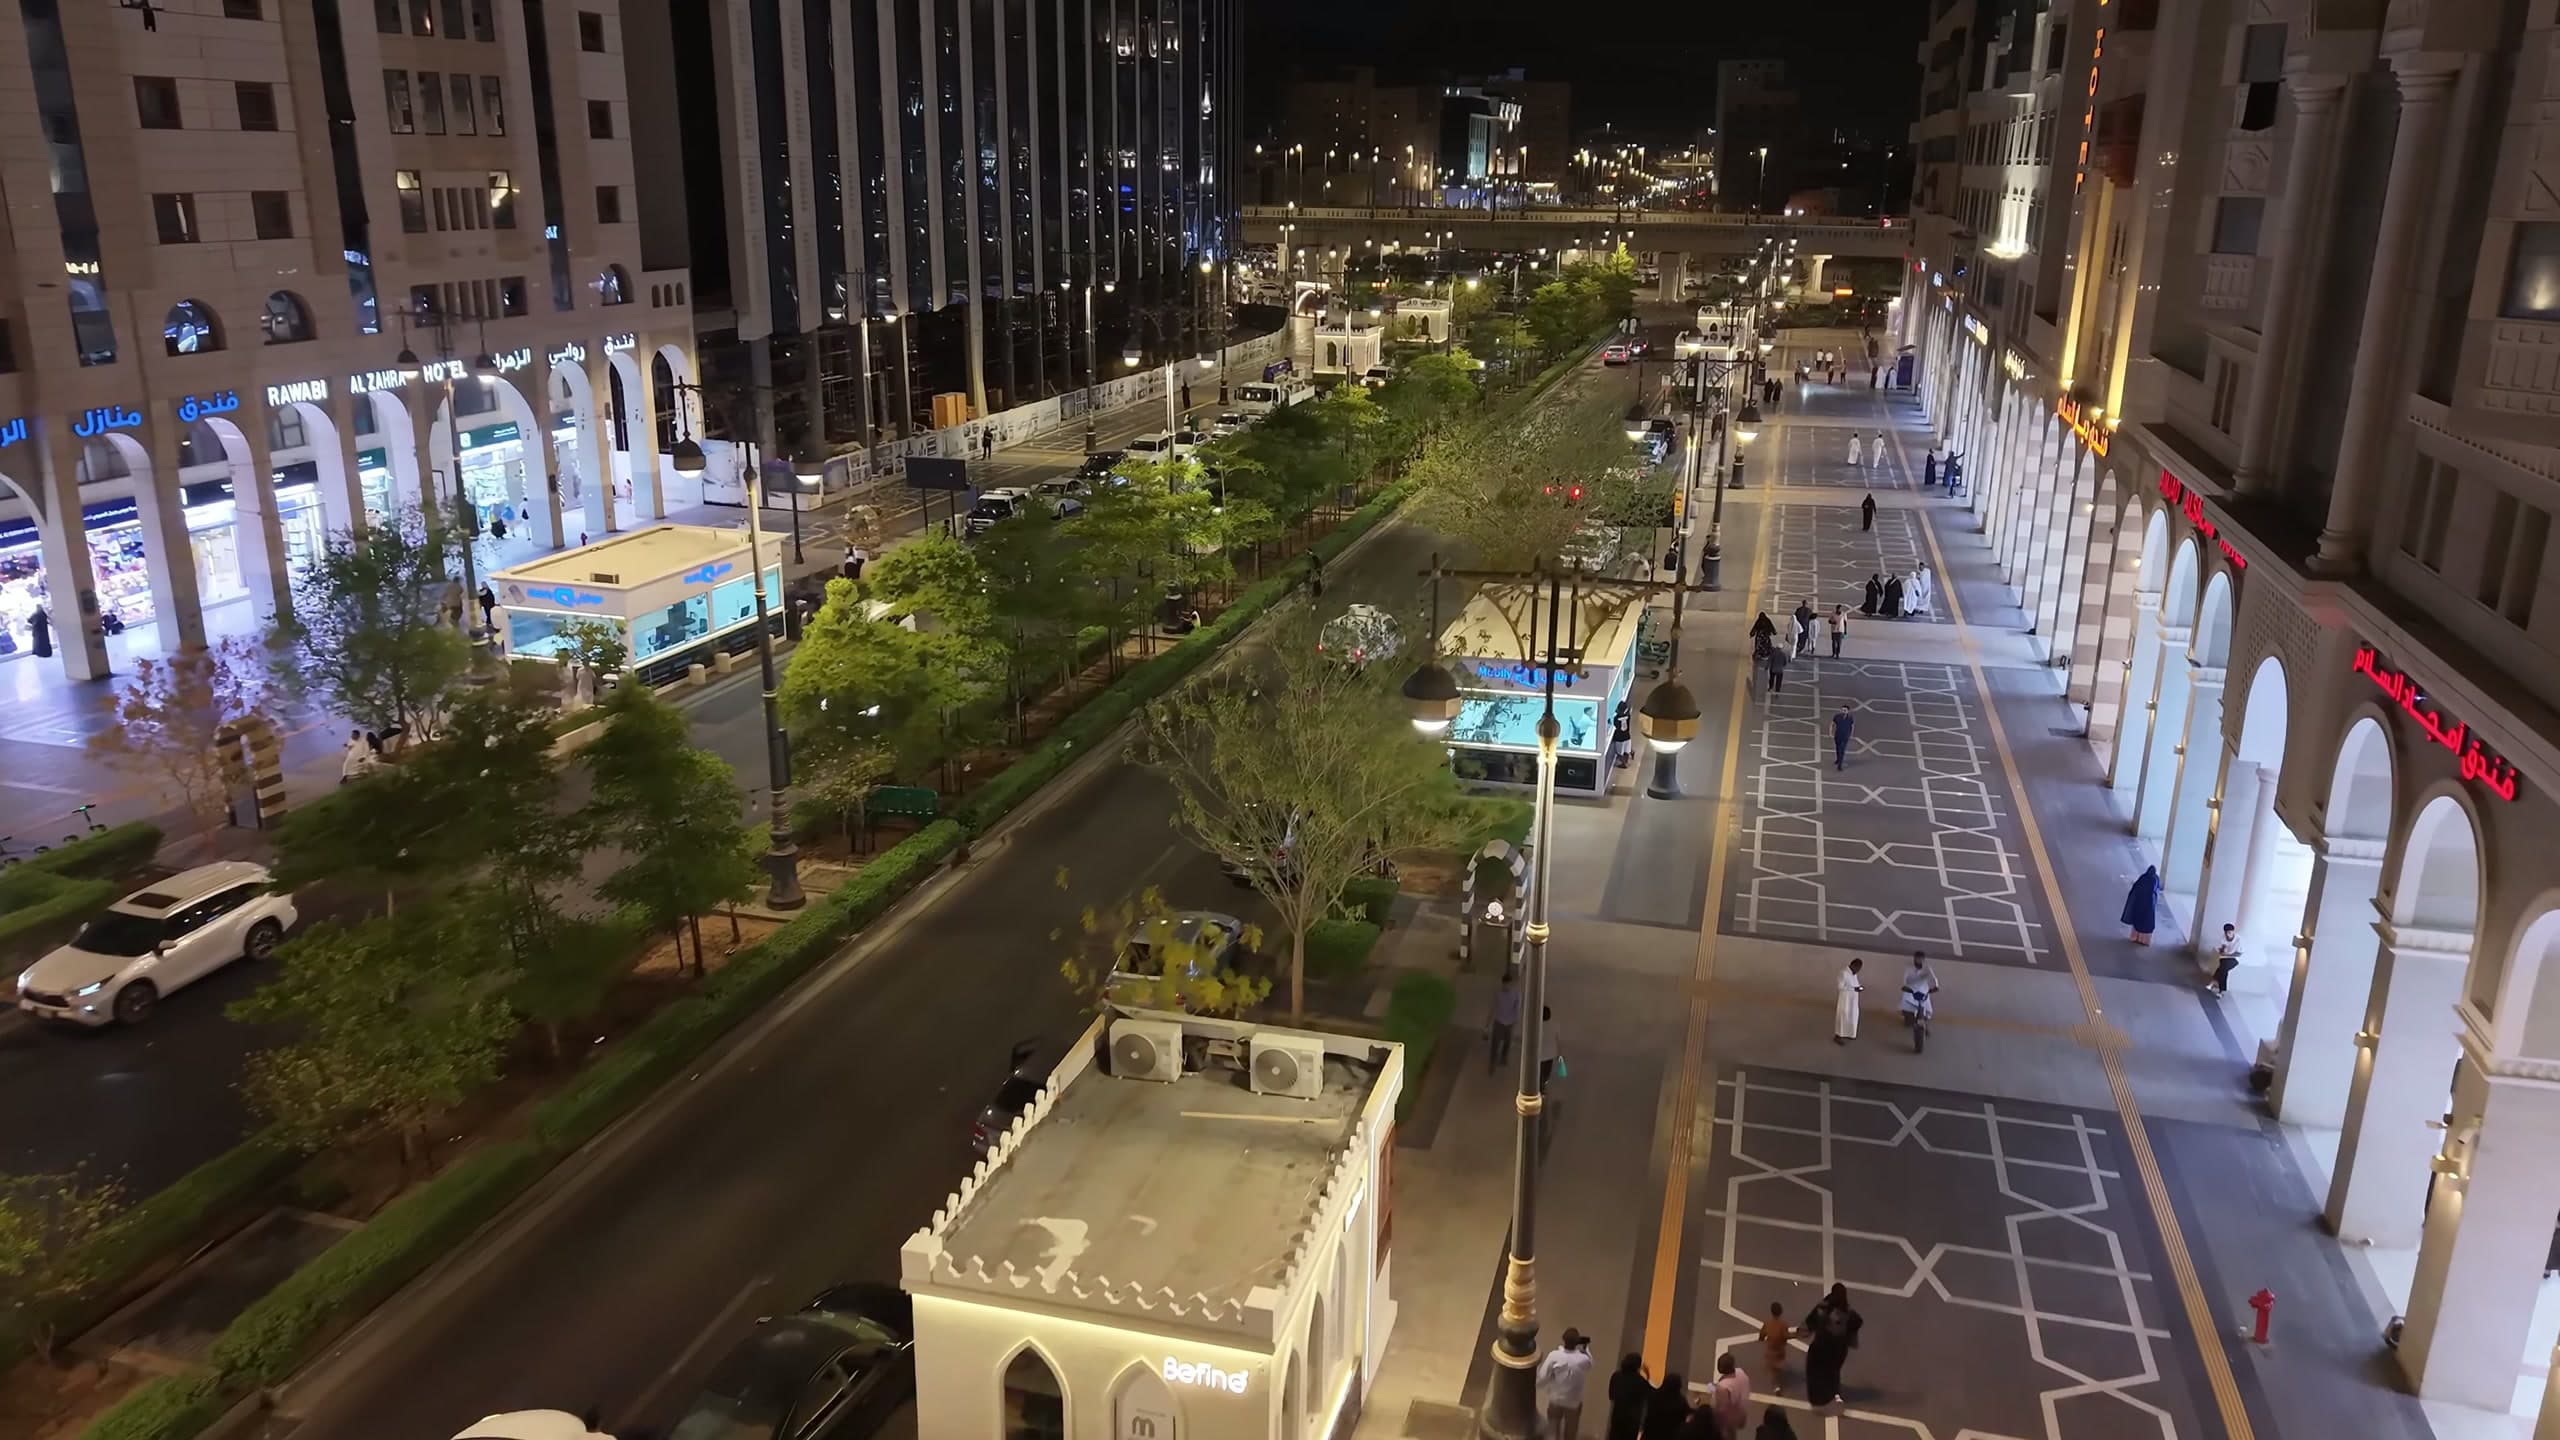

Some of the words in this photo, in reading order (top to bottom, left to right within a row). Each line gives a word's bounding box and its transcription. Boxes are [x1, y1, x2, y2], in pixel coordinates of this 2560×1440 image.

[548, 342, 585, 368] روابي
[603, 333, 636, 356] فندق
[178, 390, 240, 423] فندق
[267, 379, 328, 406] RAWABI
[73, 405, 142, 437] منازل
[2352, 648, 2405, 702] السلام
[2460, 739, 2516, 803] فندق
